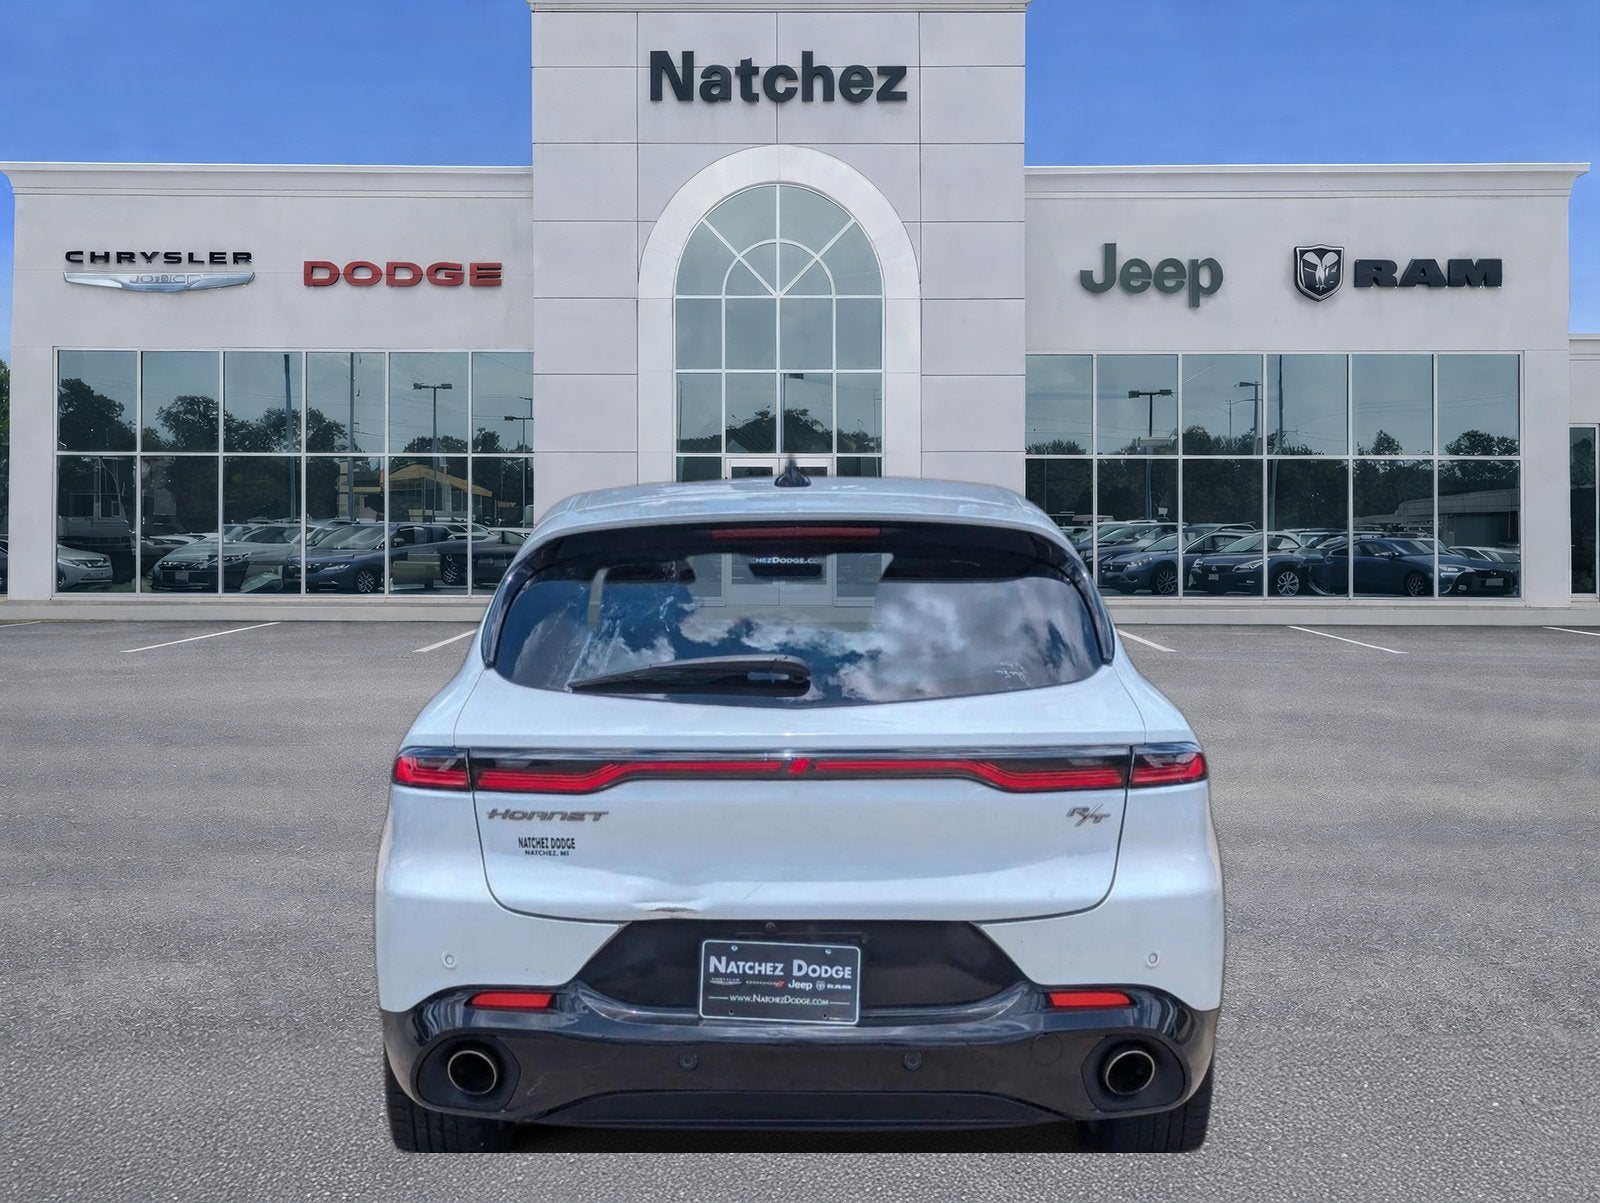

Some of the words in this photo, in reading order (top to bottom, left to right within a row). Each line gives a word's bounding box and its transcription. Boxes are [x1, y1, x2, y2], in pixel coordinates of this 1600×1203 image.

[650, 51, 908, 103] Natchez
[65, 250, 253, 265] CHRYSLER
[304, 260, 503, 287] DODGE
[1080, 243, 1224, 309] Jeep
[1354, 258, 1503, 289] RAM
[518, 837, 549, 849] NATCHEZ
[551, 838, 575, 849] DODGE
[709, 955, 784, 976] NATCHEZ
[792, 959, 852, 979] DODGE
[788, 979, 813, 990] Jeep
